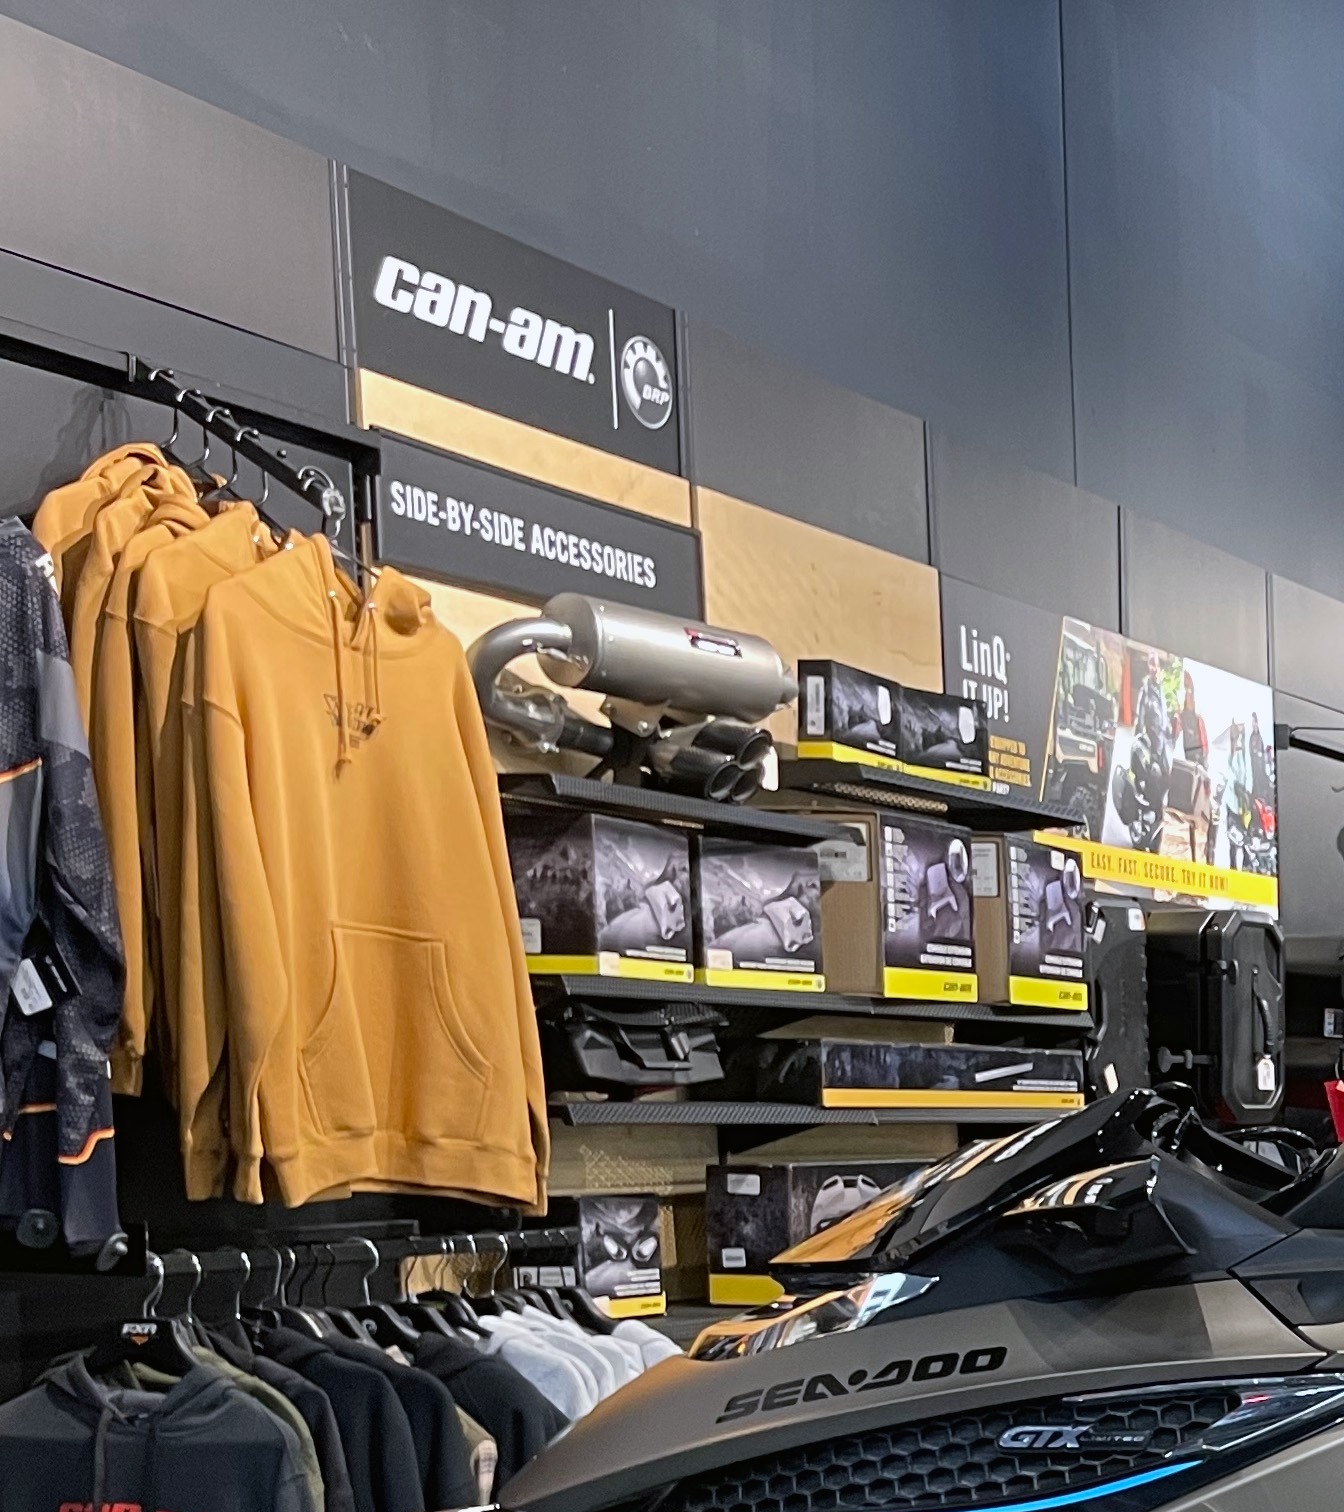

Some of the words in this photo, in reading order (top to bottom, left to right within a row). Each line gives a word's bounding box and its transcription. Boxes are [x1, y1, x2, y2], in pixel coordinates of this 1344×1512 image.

[373, 255, 595, 383] can-am
[389, 481, 527, 551] SIDE-BY-SIDE
[530, 523, 657, 589] ACCESSORIES
[1182, 868, 1196, 887] TRY
[1000, 1425, 1092, 1448] GTX
